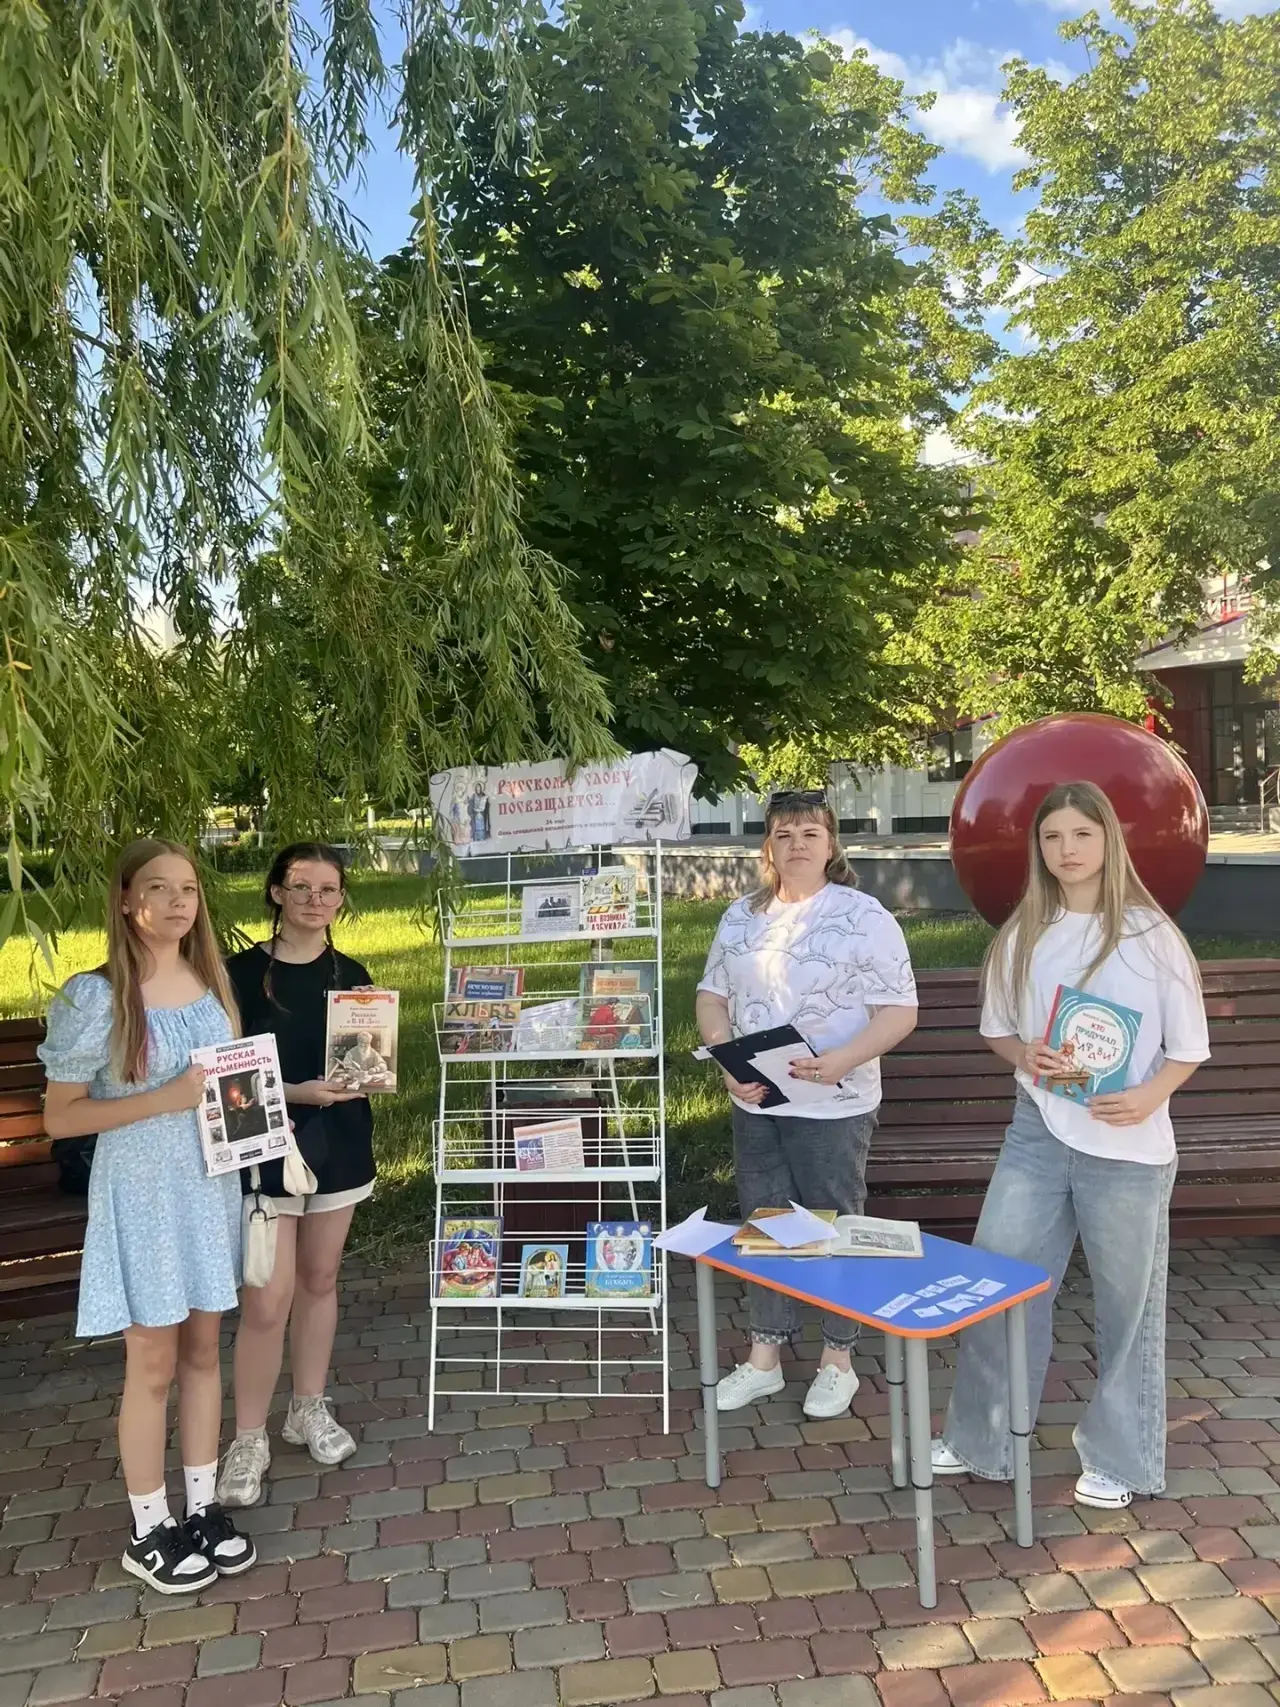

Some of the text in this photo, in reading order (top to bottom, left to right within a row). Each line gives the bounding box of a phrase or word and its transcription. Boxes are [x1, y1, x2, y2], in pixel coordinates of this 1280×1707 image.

[1090, 1022, 1105, 1033] КТО
[1075, 1025, 1117, 1046] ПРИДУМАЛ
[216, 1049, 256, 1064] РУССКАЯ
